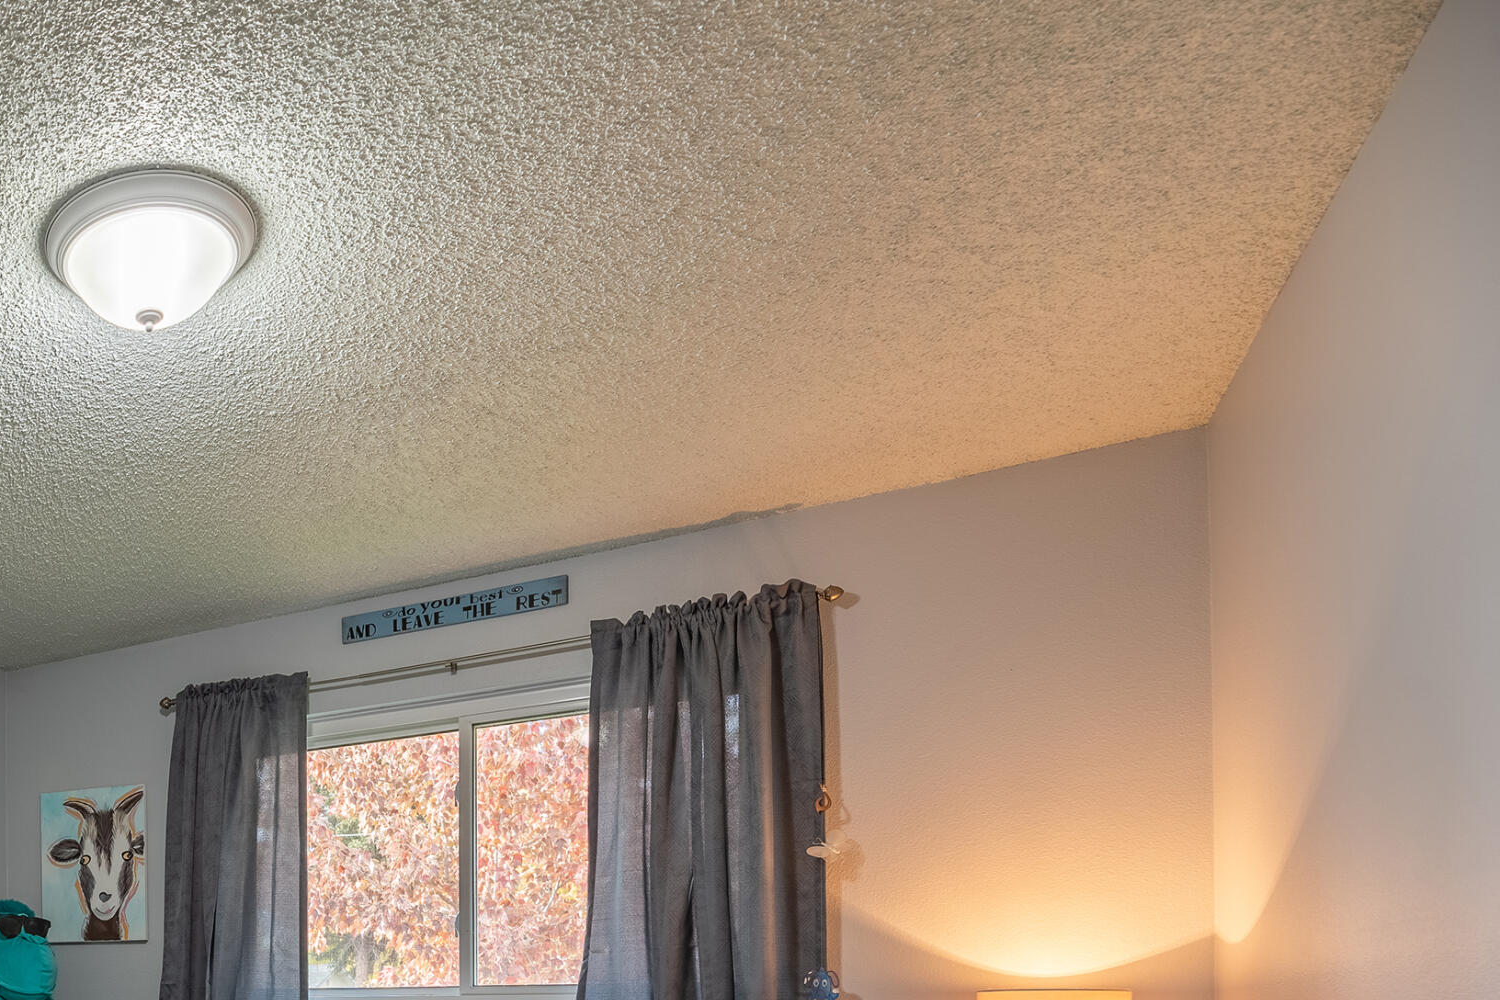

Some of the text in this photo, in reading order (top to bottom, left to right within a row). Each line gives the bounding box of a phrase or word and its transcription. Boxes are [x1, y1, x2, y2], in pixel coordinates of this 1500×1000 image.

[346, 589, 562, 641] AND LEAVE THE REST
[398, 589, 503, 617] do your best
